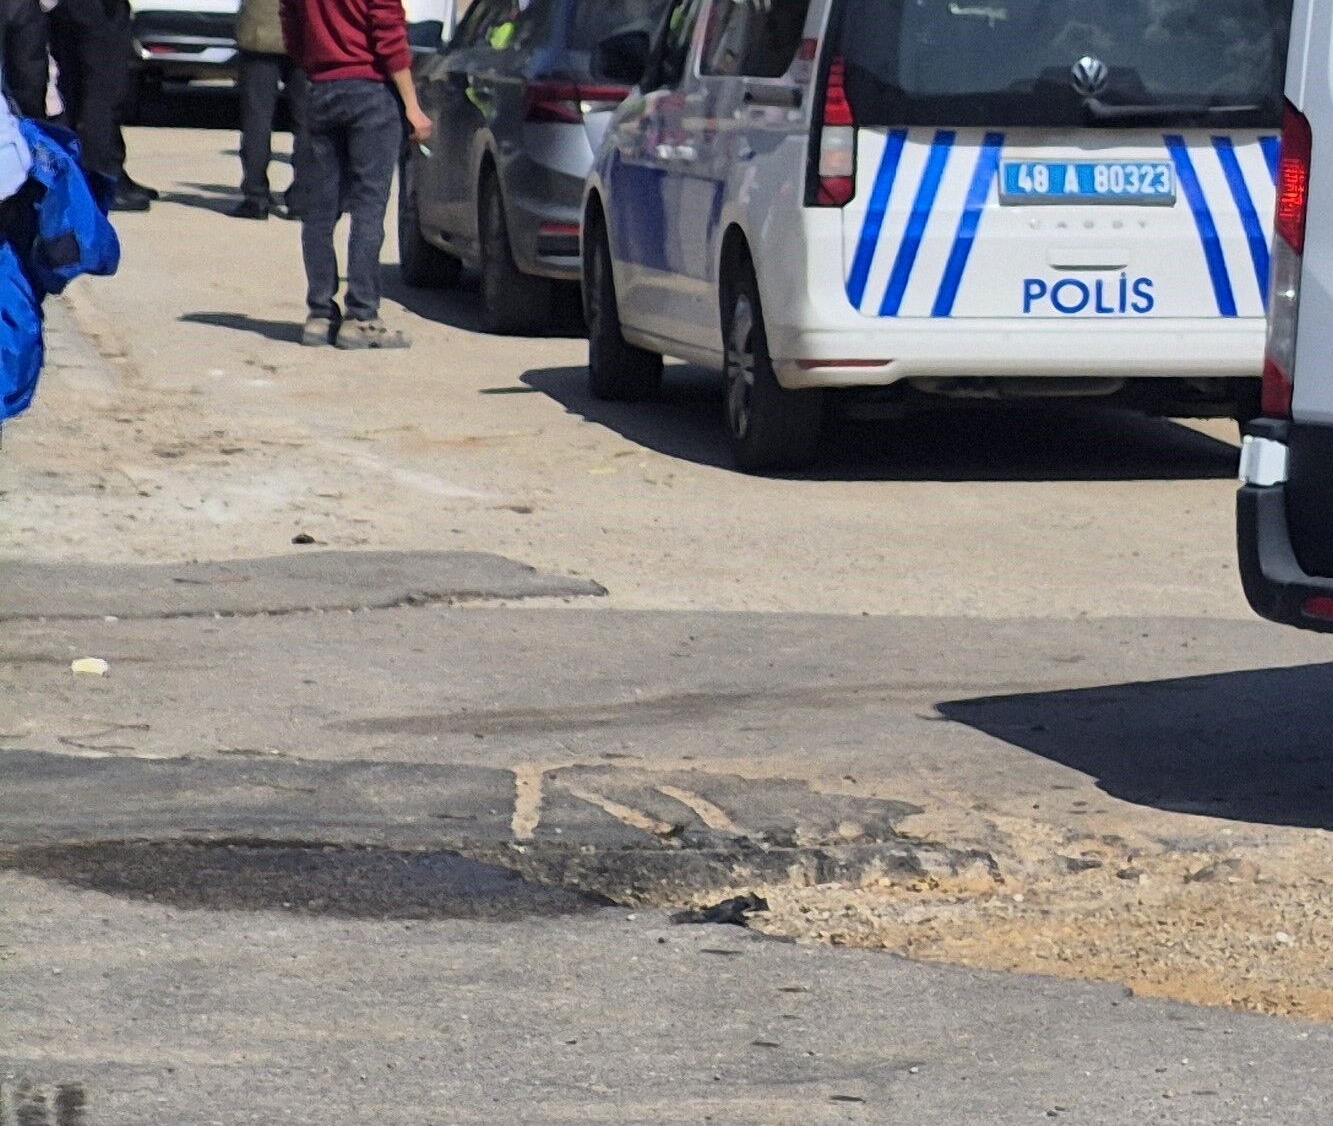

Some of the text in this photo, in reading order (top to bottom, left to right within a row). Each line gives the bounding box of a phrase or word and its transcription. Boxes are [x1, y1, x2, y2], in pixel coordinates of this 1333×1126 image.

[1018, 165, 1171, 194] 48 A 80323
[1023, 272, 1154, 314] POLİS
